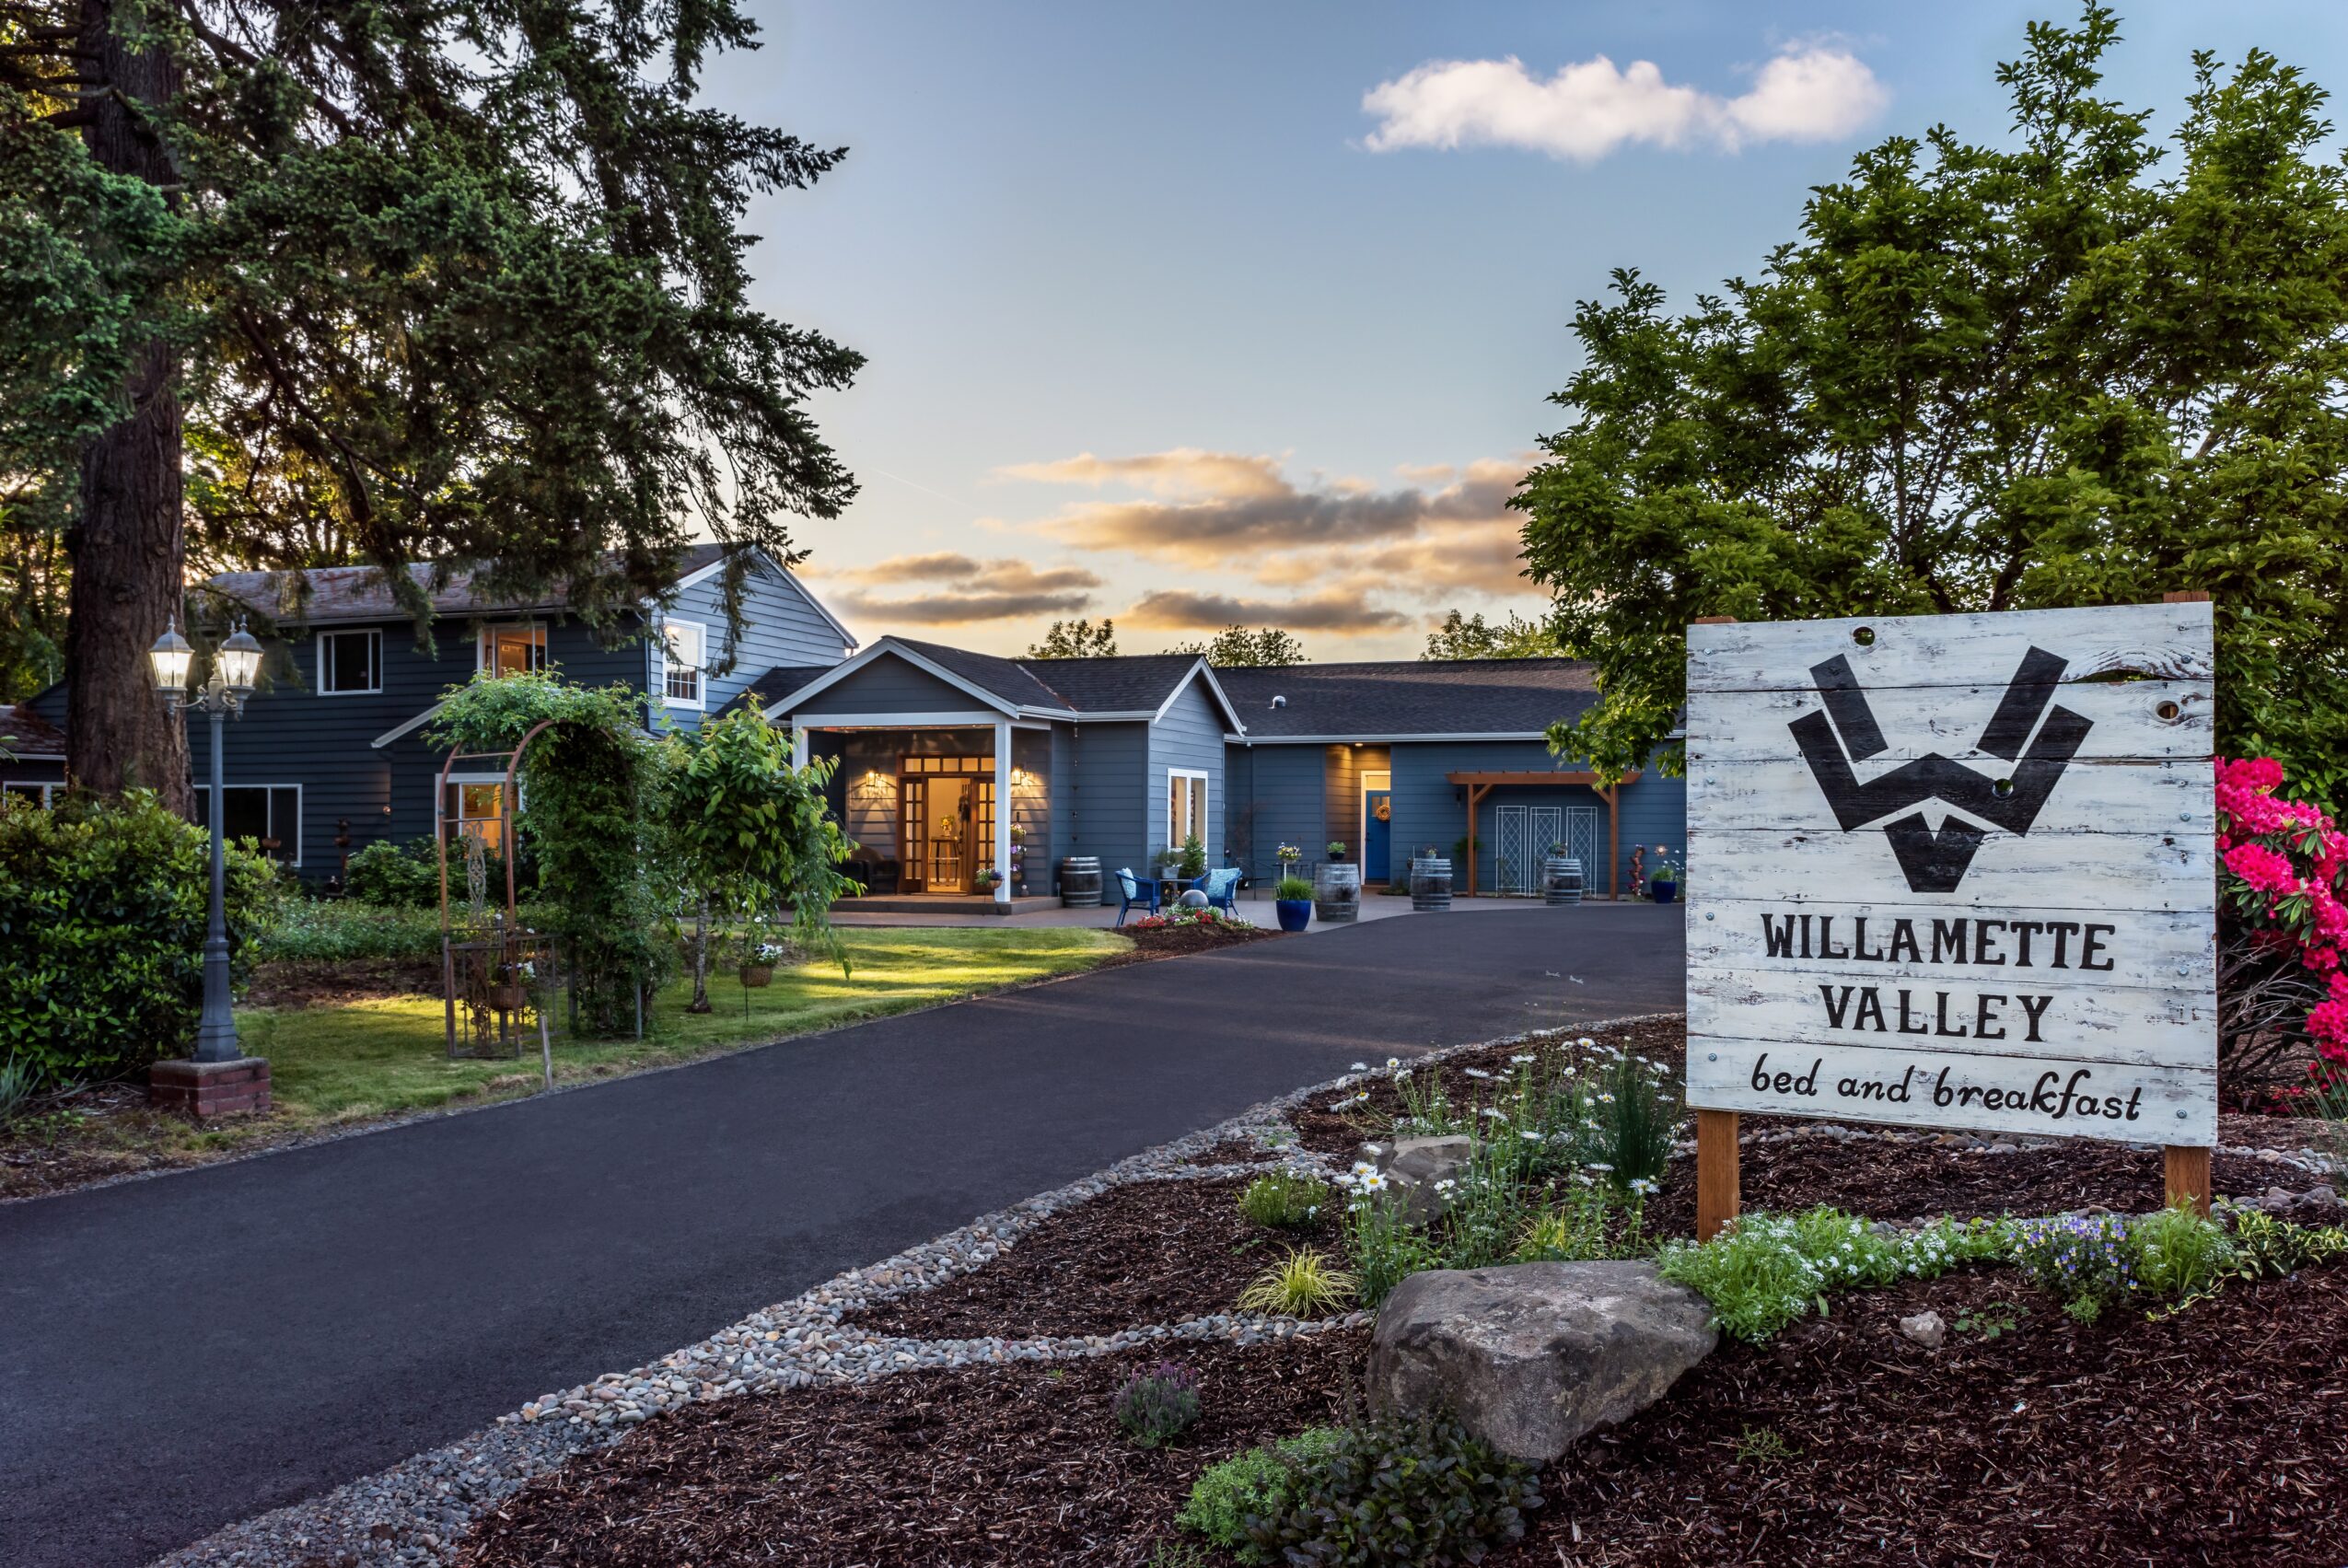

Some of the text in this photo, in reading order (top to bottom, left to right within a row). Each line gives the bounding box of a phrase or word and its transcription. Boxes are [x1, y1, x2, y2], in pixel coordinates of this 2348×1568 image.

[1760, 913, 2116, 971] WILLAMETTE
[1818, 984, 2054, 1042] VALLEY
[1750, 1052, 2143, 1121] bed and breakfast
